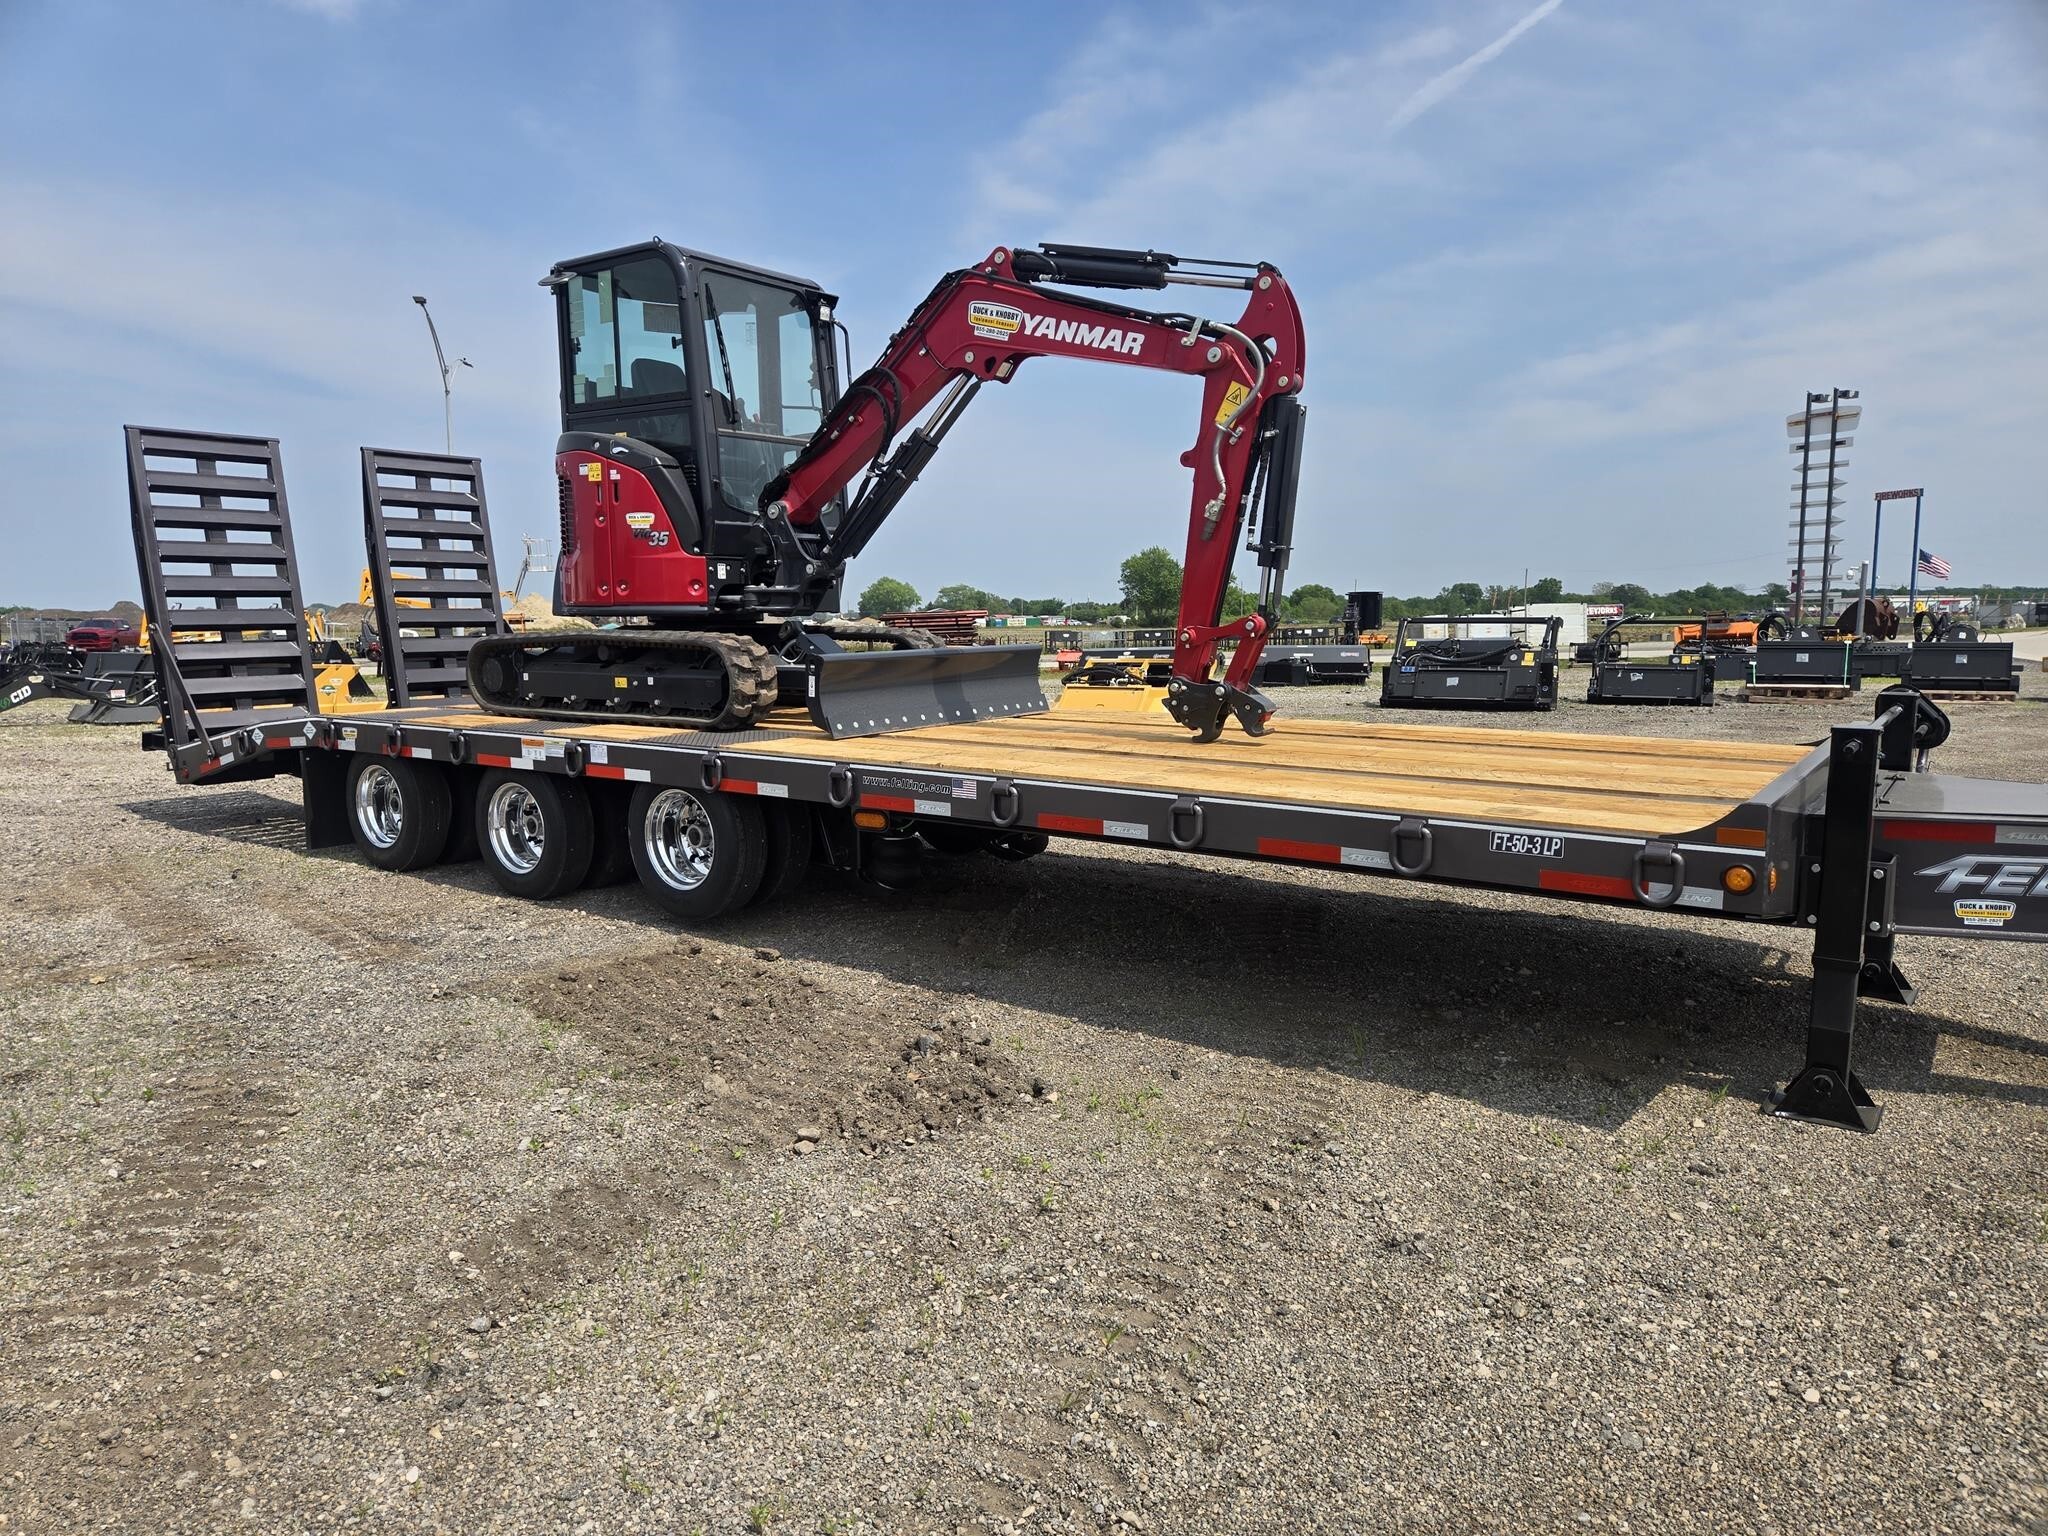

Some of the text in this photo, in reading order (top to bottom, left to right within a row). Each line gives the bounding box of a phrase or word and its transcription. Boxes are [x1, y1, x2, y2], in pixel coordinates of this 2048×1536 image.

[972, 305, 1020, 321] BUCK & KNOBBY
[1023, 312, 1146, 356] YANMAR
[1874, 489, 1919, 501] FIREWORKS
[10, 685, 32, 704] CID
[862, 775, 951, 795] www.felling.com
[1492, 832, 1561, 856] FT-50-3 LP
[1959, 902, 1977, 910] BUCK
